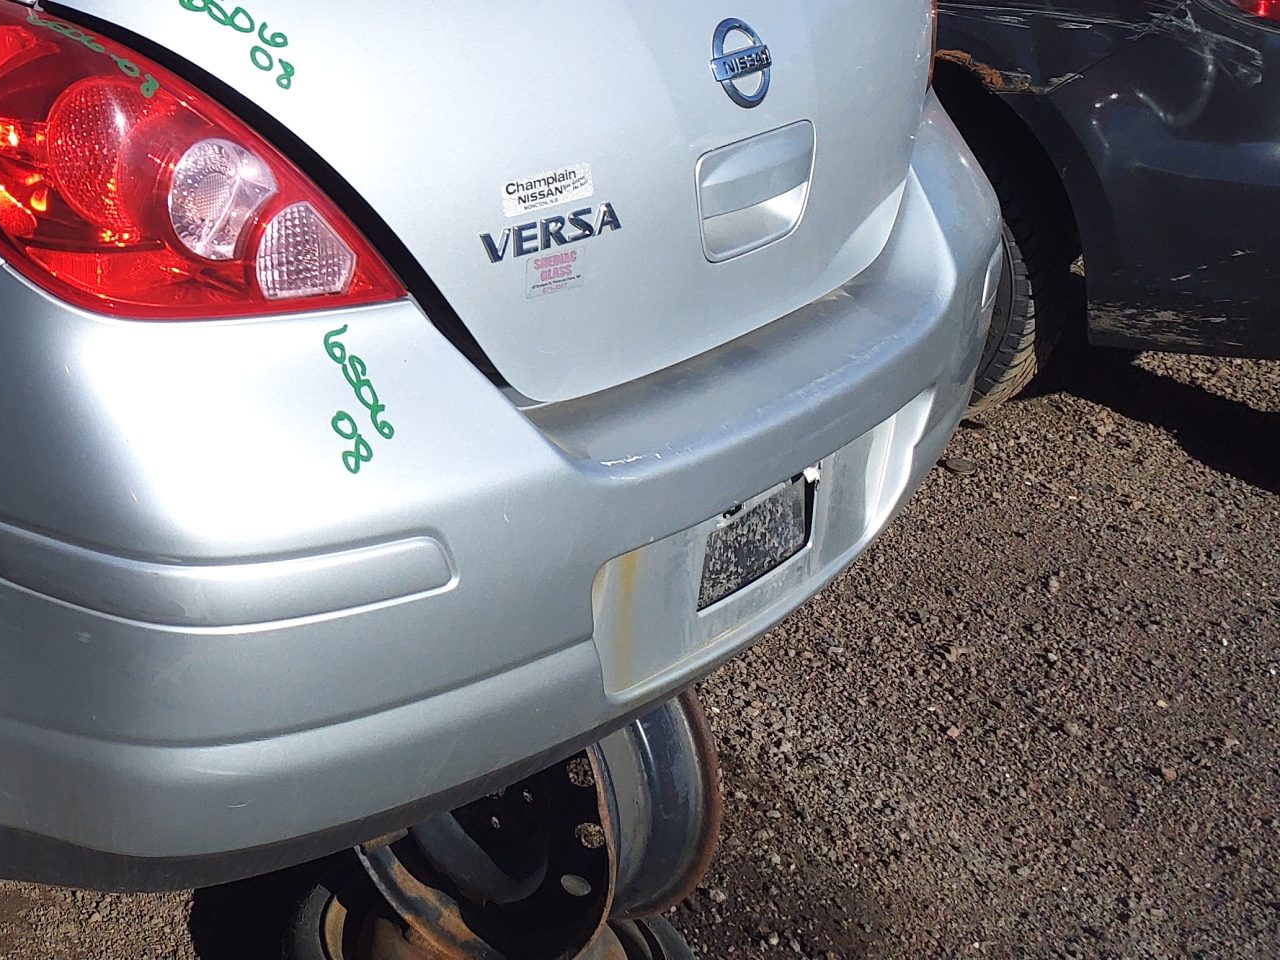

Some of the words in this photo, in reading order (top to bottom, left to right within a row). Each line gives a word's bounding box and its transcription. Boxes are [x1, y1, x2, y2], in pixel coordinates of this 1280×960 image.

[249, 45, 295, 90] 08
[722, 50, 770, 75] NISSAN
[505, 169, 577, 195] Champlain
[517, 185, 564, 205] NISSAN
[479, 201, 622, 264] VERSA
[540, 264, 573, 282] GLASS
[331, 410, 373, 474] 08
